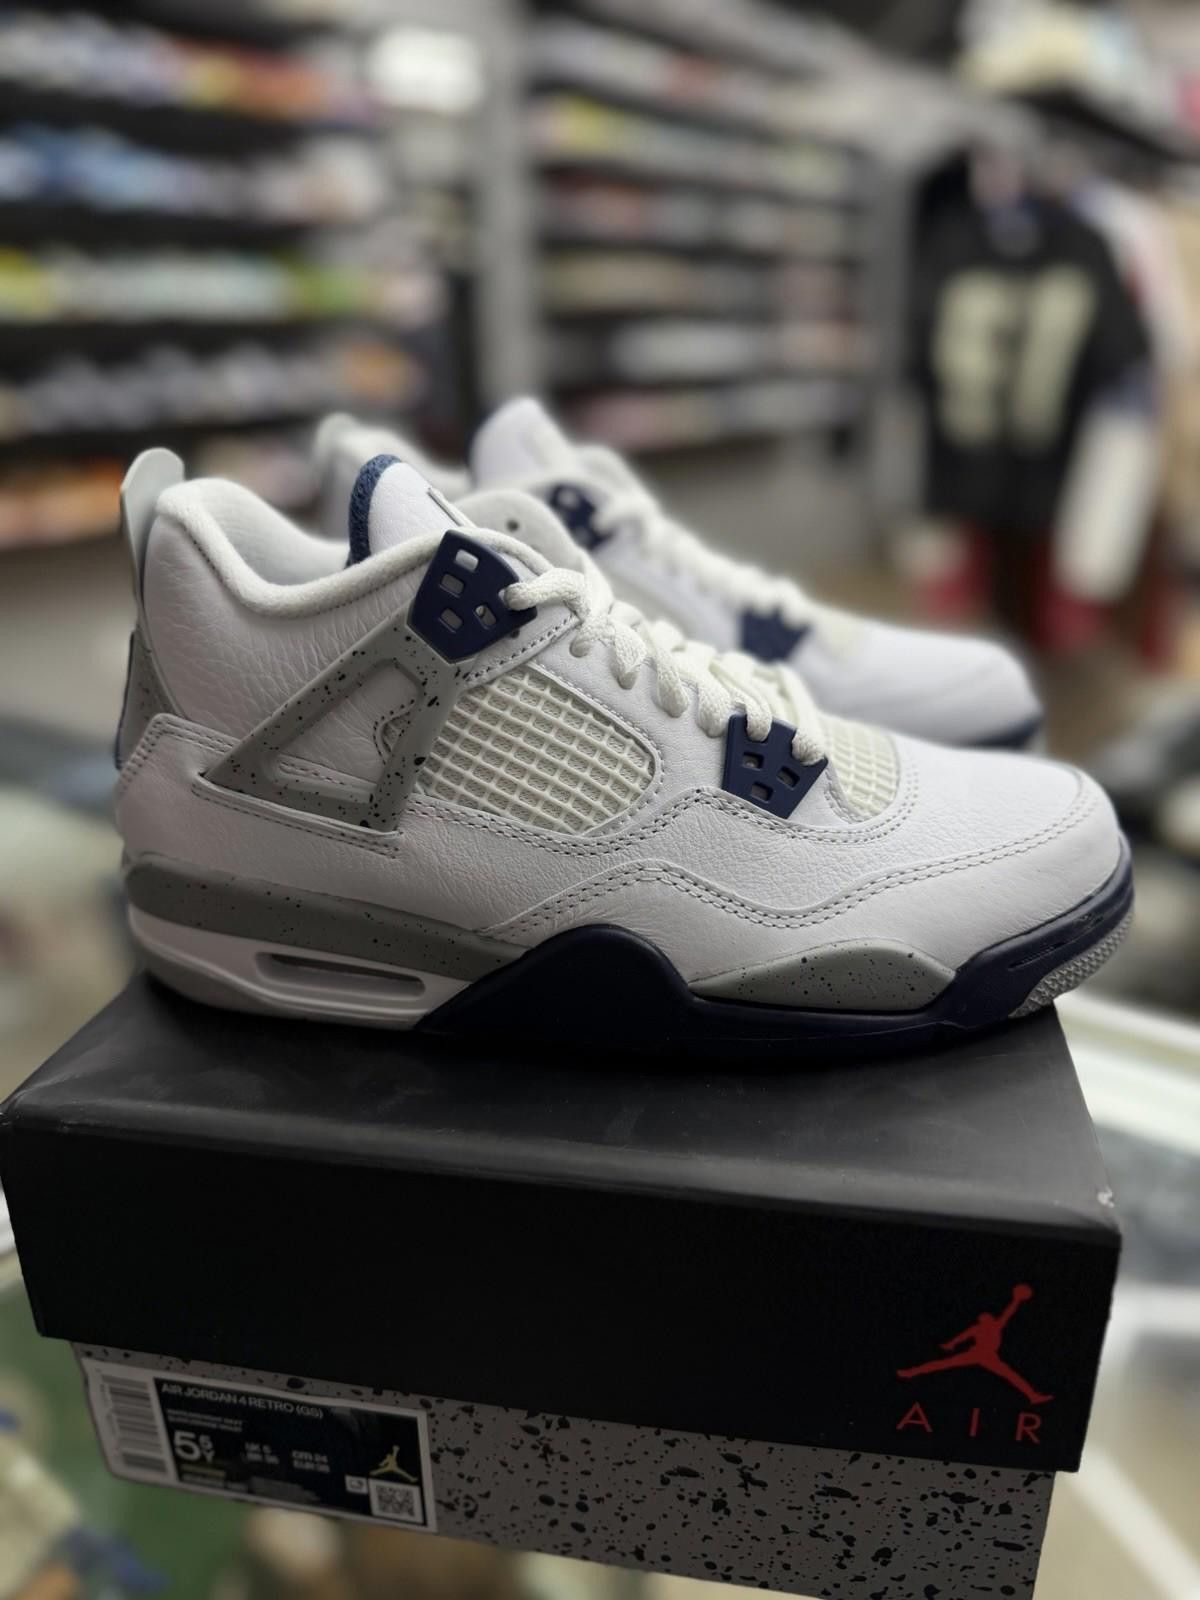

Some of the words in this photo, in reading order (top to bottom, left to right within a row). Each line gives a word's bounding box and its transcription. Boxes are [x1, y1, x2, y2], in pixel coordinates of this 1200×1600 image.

[161, 1382, 183, 1397] AIR
[184, 1386, 237, 1405] JORDAN
[238, 1395, 247, 1407] 4
[248, 1397, 294, 1414] RETRO
[296, 1403, 324, 1420] (GS)
[896, 1400, 1042, 1445] AIR
